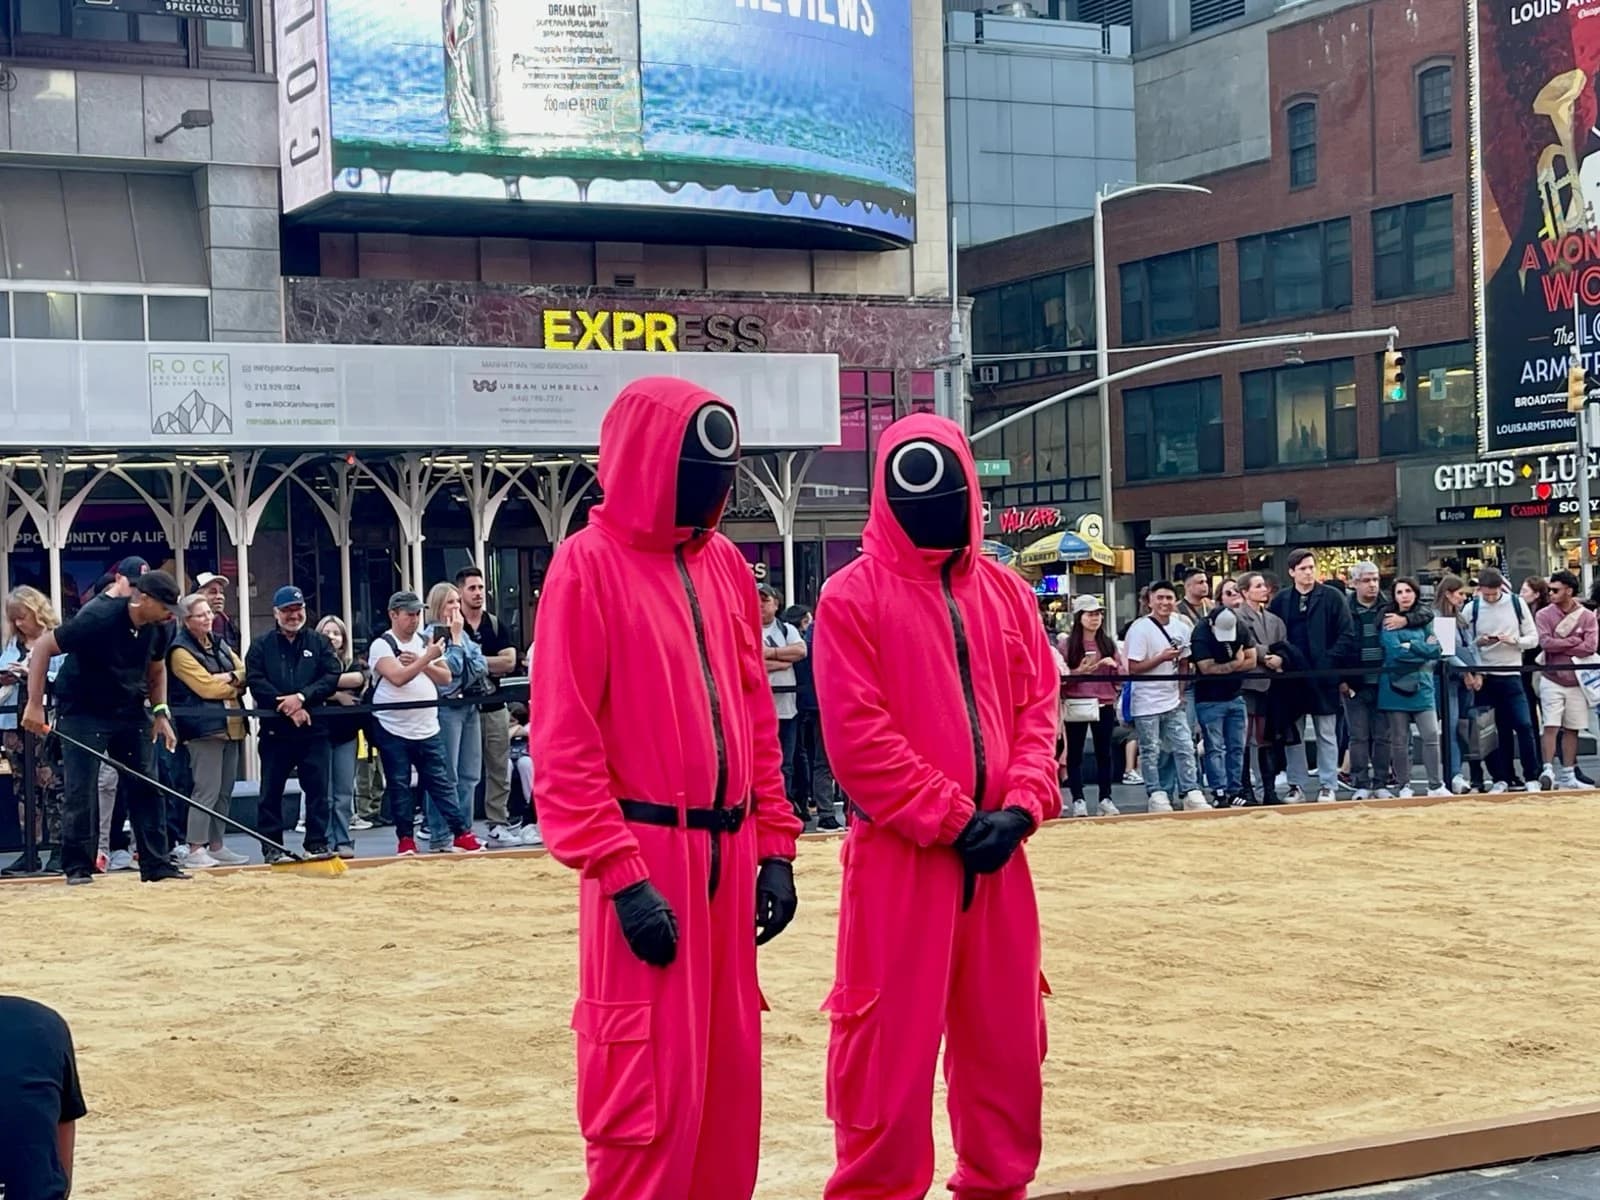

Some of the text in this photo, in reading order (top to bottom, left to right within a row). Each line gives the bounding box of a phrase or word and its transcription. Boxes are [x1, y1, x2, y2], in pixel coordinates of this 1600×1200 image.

[165, 2, 240, 16] SPECTACOLOR
[548, 4, 597, 17] DREAM COAT
[1511, 0, 1562, 25] LOUIS
[589, 20, 609, 28] SPRAY
[1519, 243, 1541, 271] A
[543, 310, 768, 352] EXPRESS
[1553, 325, 1575, 346] The
[152, 359, 225, 373] ROCK
[500, 383, 600, 393] URBAN UMBRELLA
[1496, 418, 1577, 435] LOUISARMSTRONG
[1434, 459, 1516, 491] GIFTS
[1531, 482, 1577, 500] I NY
[1448, 499, 1600, 521] Apple Nikon Canon SOY
[15, 531, 106, 544] PPOUNITY
[110, 531, 128, 543] OF
[132, 531, 142, 543] A
